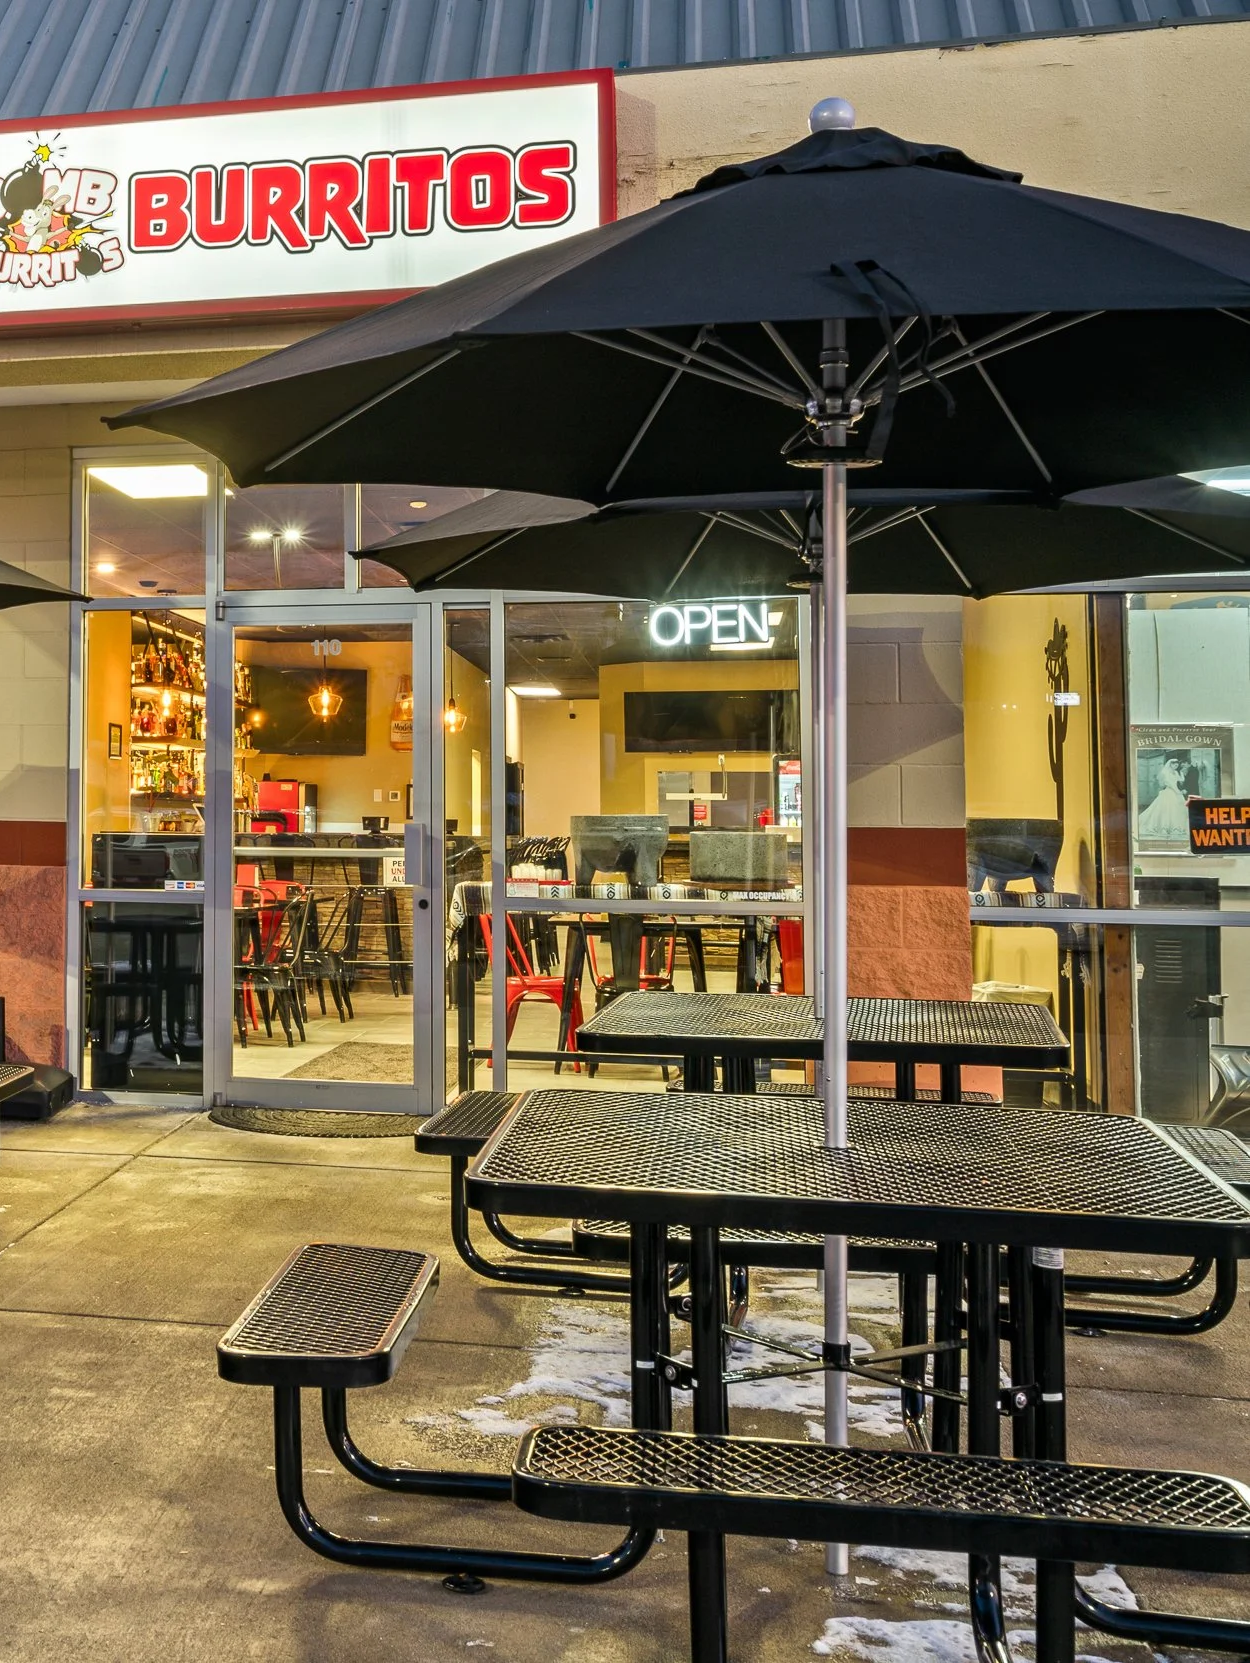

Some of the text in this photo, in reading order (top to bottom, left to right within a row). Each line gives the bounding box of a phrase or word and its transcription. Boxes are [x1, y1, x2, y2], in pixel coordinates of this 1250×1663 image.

[127, 140, 577, 254] BURRITOS
[650, 603, 769, 646] OPEN
[310, 639, 342, 656] 110
[1137, 735, 1223, 747] BRIDAL GOWN
[1205, 807, 1250, 825] HELP
